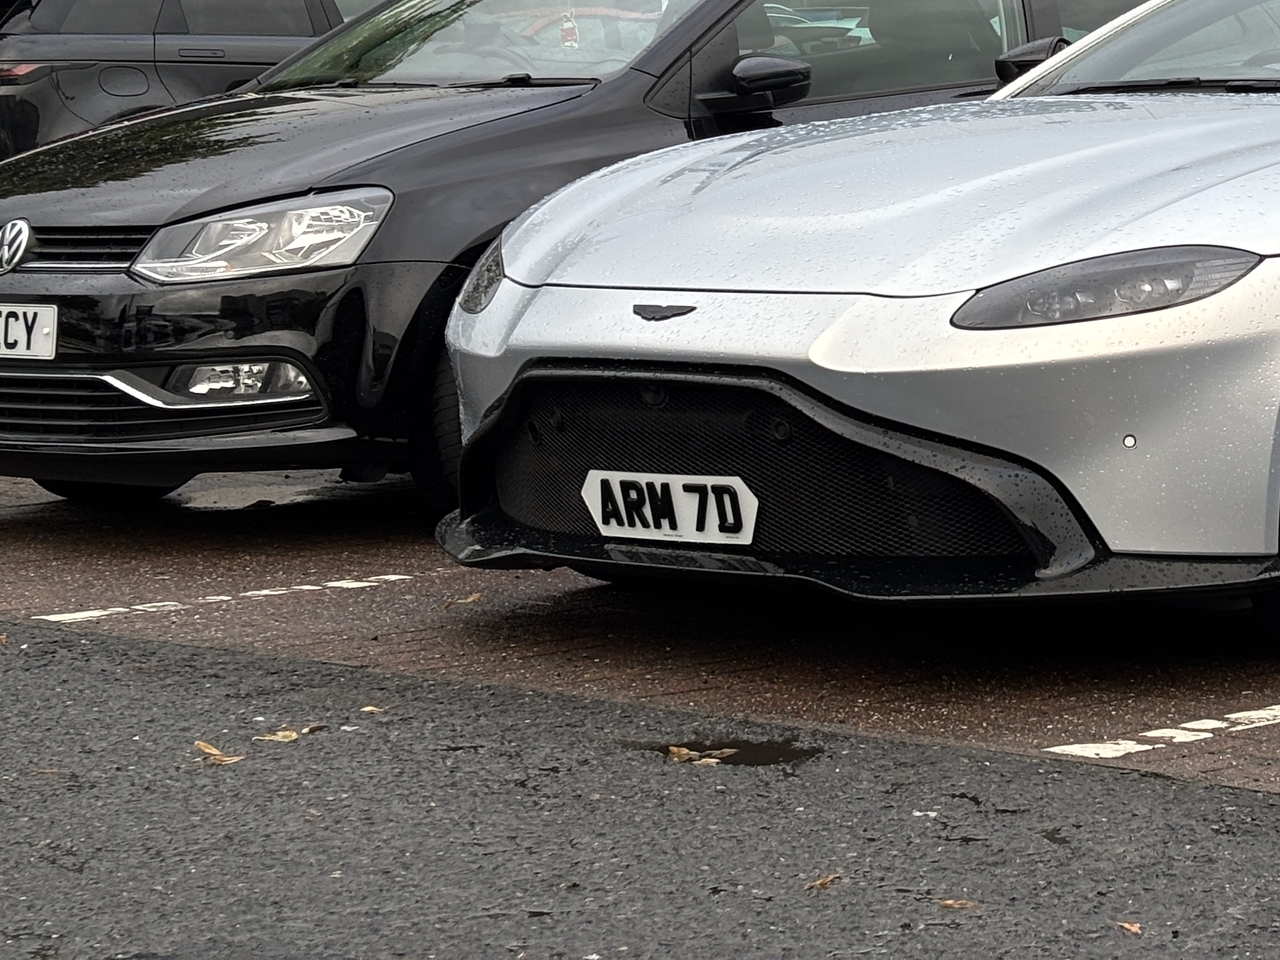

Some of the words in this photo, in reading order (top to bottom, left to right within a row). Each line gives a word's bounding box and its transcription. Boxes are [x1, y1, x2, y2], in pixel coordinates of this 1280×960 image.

[0, 311, 38, 351] CY
[600, 478, 678, 531] ARM
[682, 483, 743, 534] 7D
